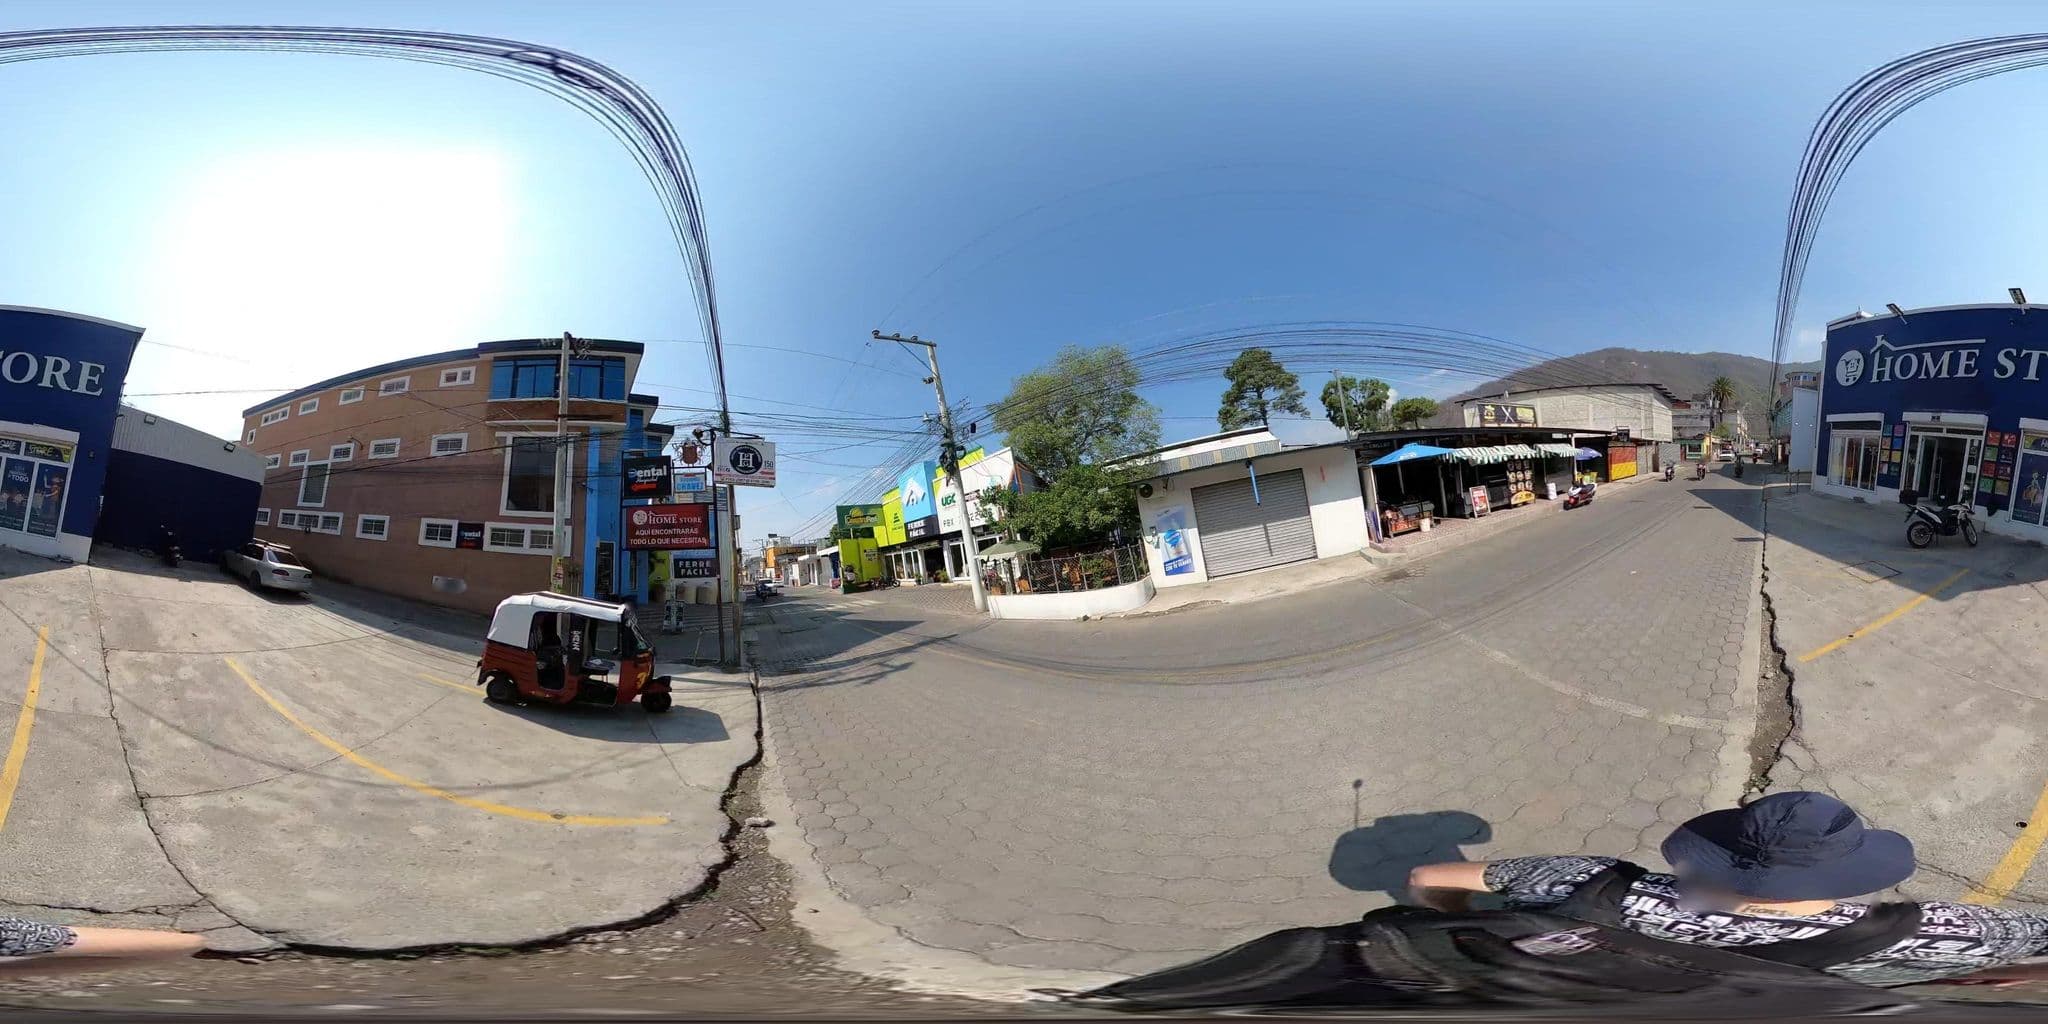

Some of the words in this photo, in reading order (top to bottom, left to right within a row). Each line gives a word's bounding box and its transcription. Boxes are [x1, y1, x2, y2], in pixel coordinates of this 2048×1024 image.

[0, 350, 105, 397] ORE
[1869, 347, 1980, 384] HOME
[648, 515, 678, 525] HOME
[679, 516, 703, 524] STORE
[678, 560, 712, 568] FERRE
